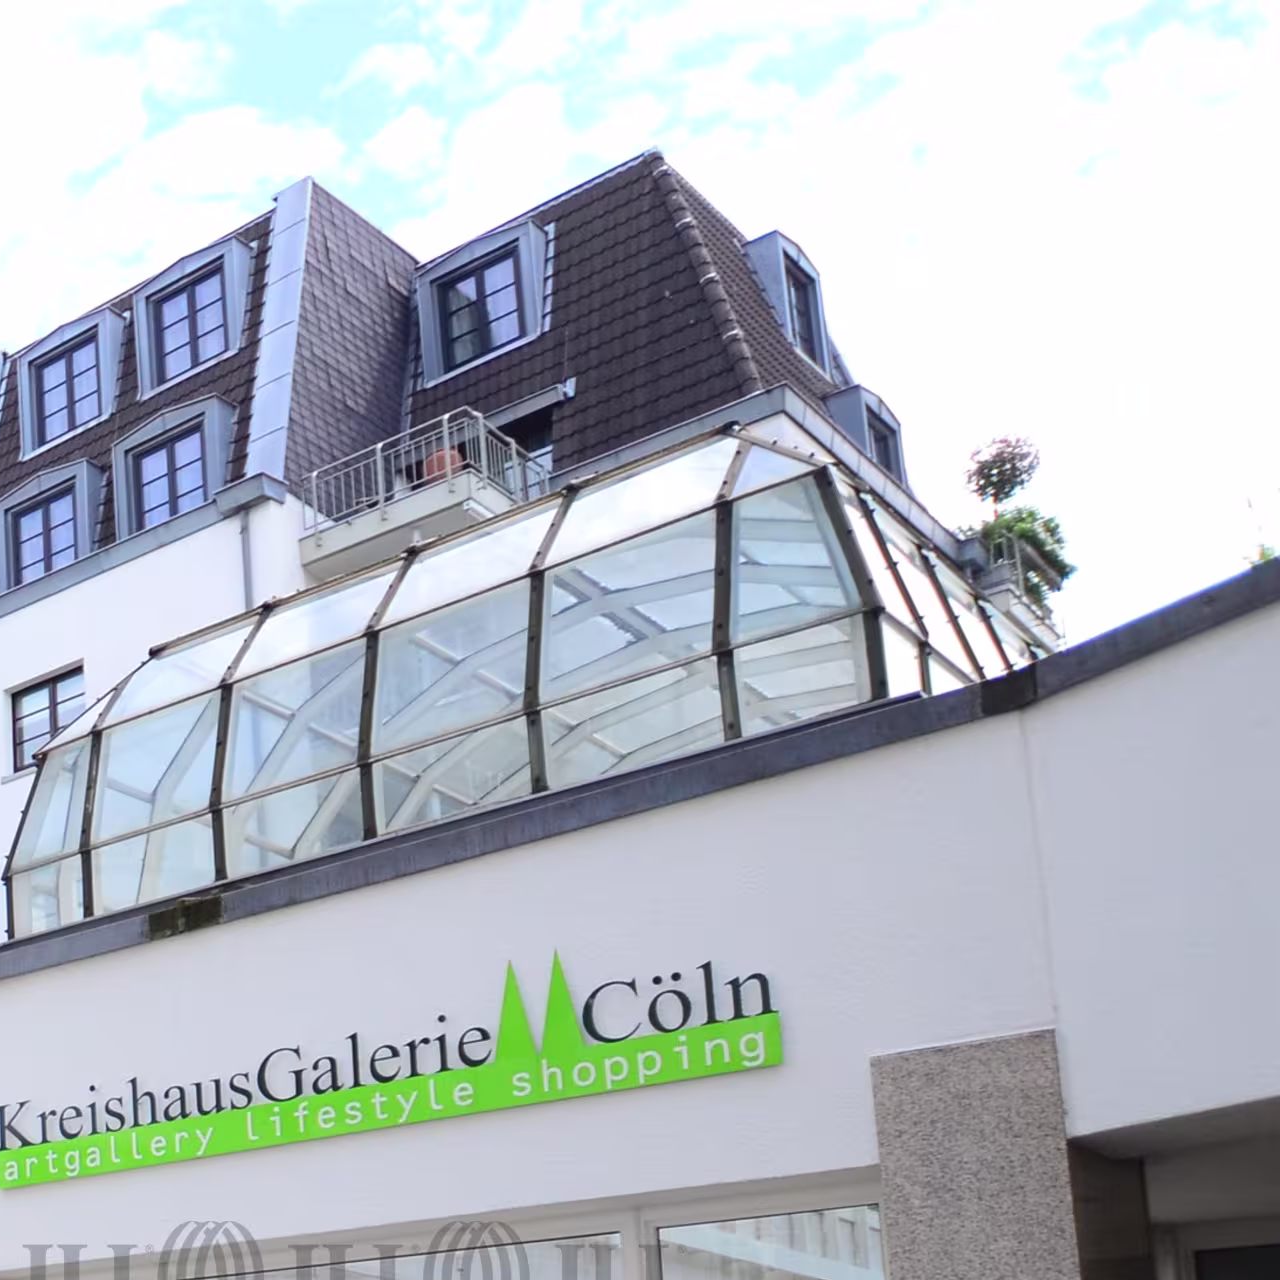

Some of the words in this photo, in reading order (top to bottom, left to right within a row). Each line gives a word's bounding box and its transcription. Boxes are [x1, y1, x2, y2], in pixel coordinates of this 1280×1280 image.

[582, 960, 780, 1044] Cöln
[4, 1126, 215, 1181] artgallery
[246, 1079, 475, 1141] lifestyle
[512, 1030, 766, 1097] shopping
